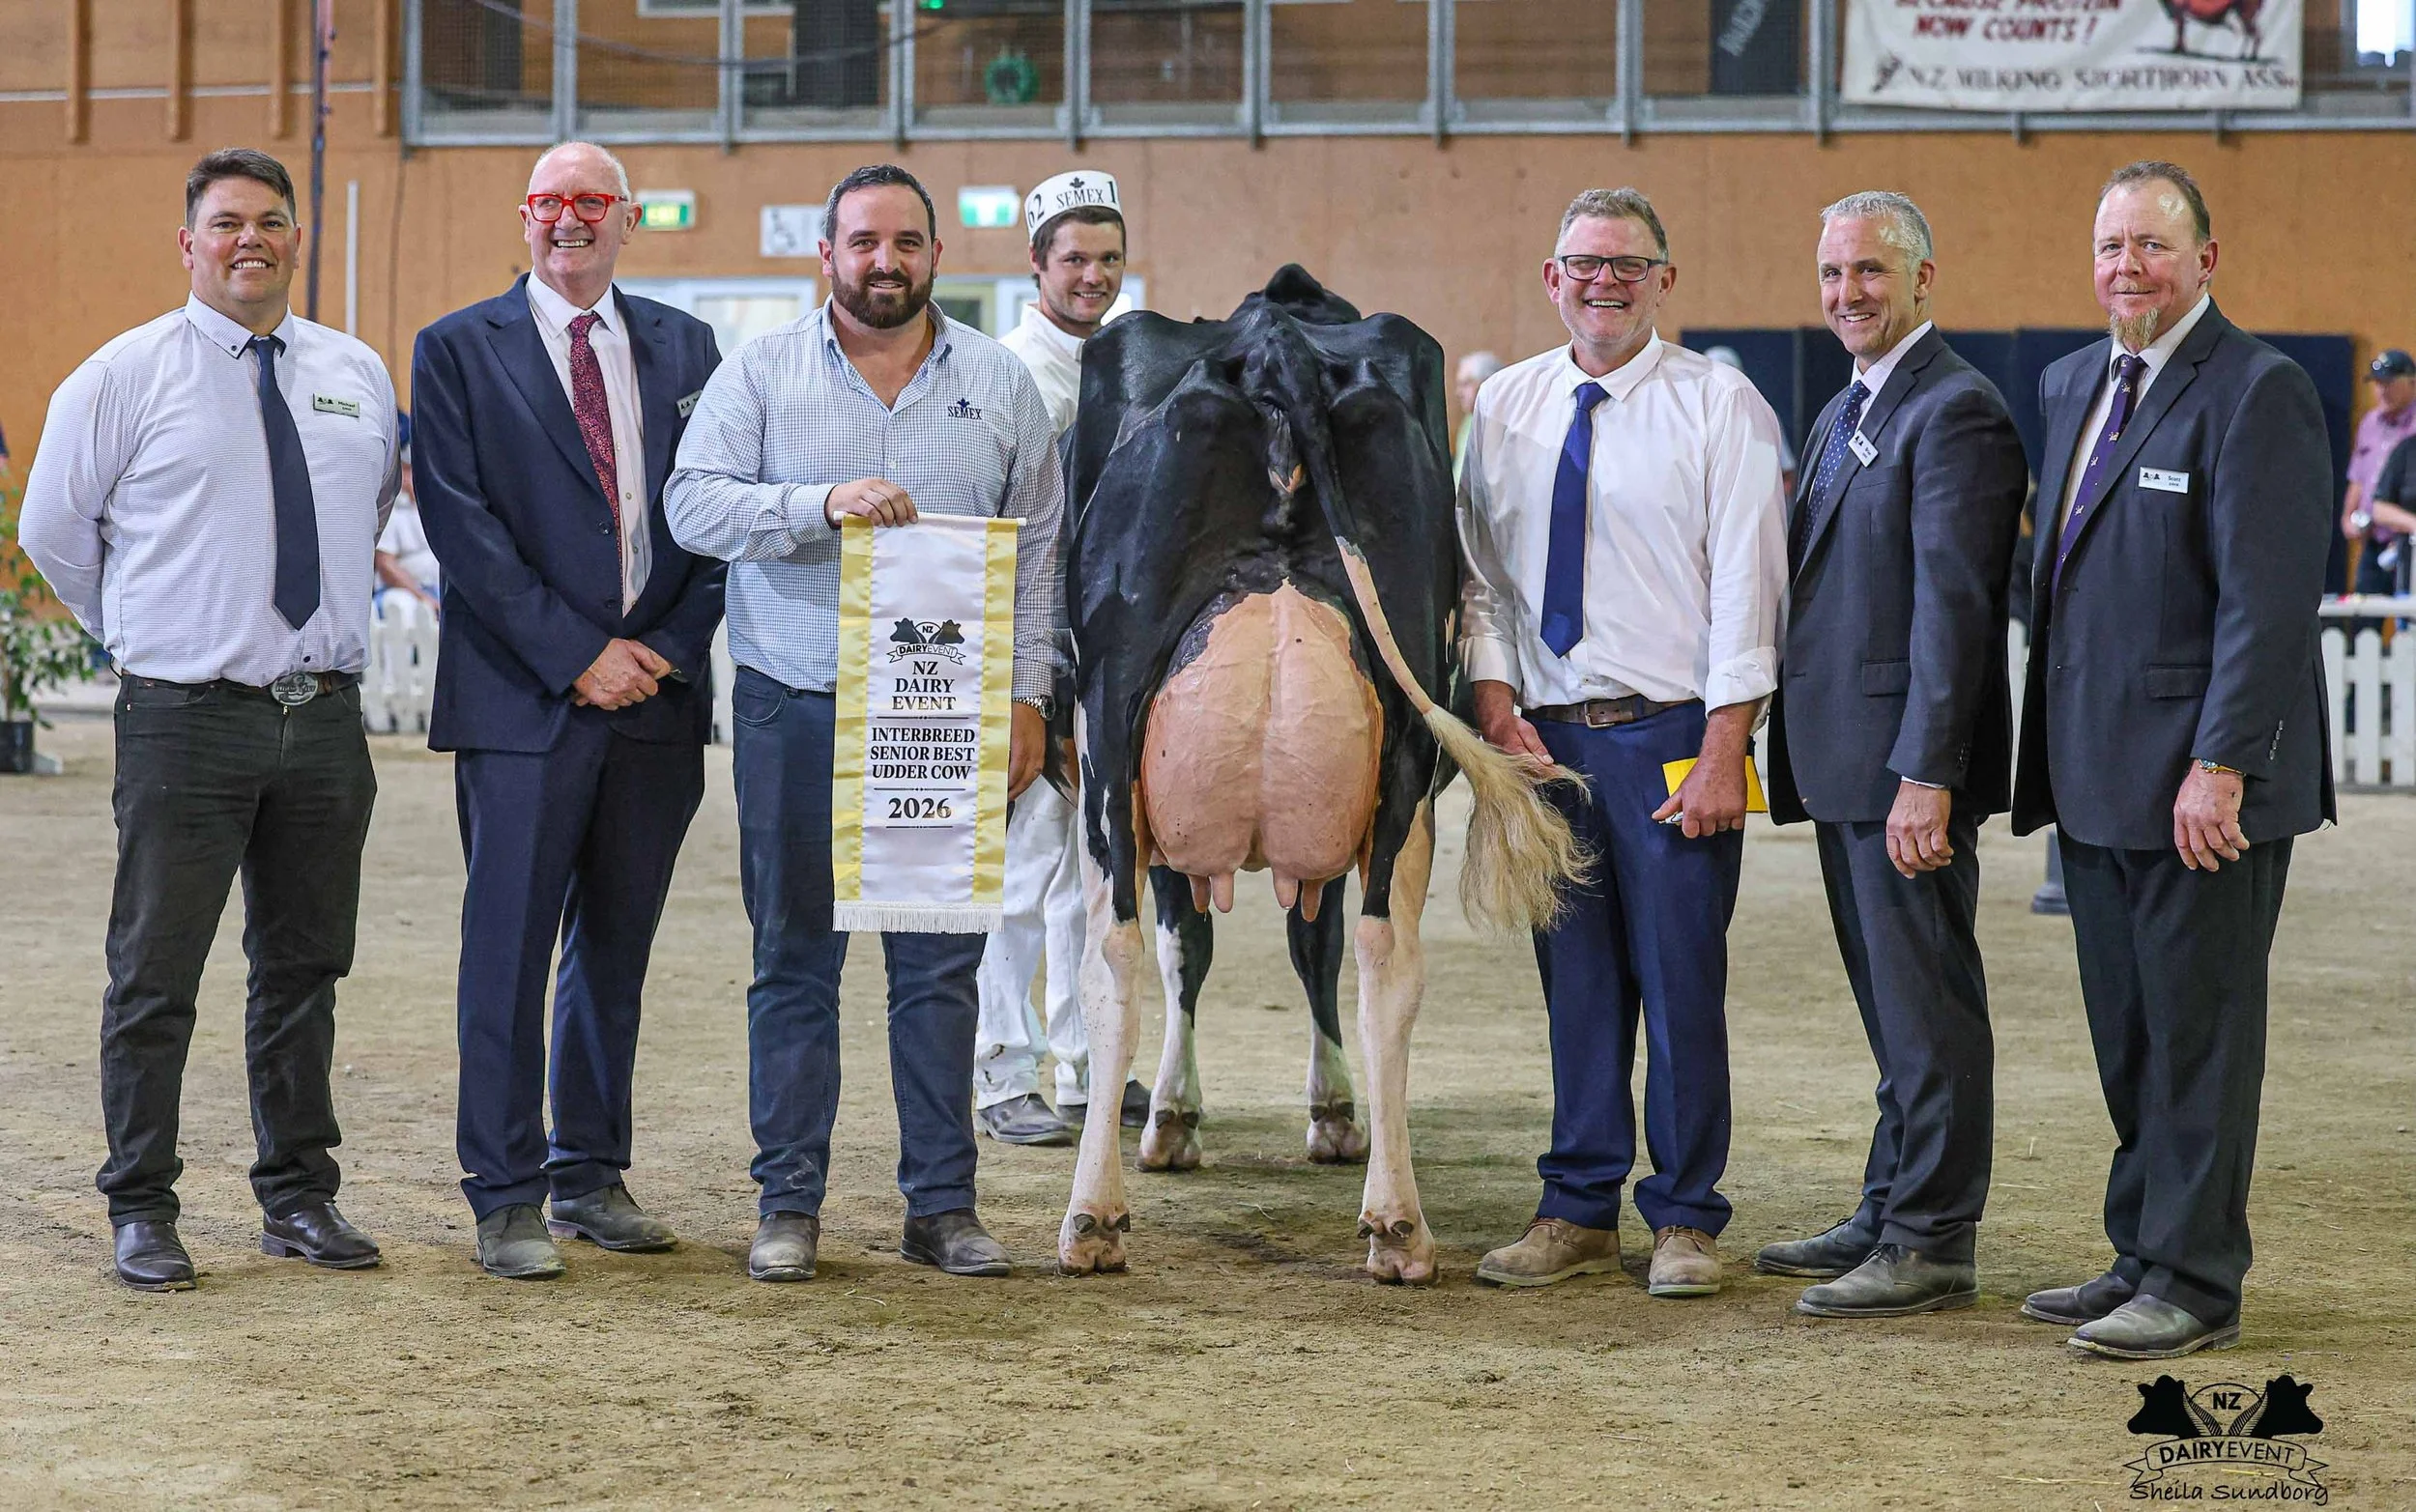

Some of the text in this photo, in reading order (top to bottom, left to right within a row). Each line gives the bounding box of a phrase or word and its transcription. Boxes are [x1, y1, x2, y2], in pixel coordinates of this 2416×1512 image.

[1913, 14, 1973, 37] NOW
[1983, 17, 2077, 41] COUNTS
[1056, 188, 1105, 210] SEMEX
[1107, 181, 1117, 204] 1
[1027, 193, 1045, 229] 62
[947, 406, 983, 420] SEMEX
[922, 625, 935, 634] NZ
[912, 661, 938, 675] NZ
[894, 678, 955, 693] DAIRY
[892, 696, 957, 710] EVENT
[872, 727, 975, 742] INTERBREED
[870, 746, 975, 761] SENIOR BEST
[872, 764, 972, 780] UDDER COW
[888, 797, 952, 818] 2026
